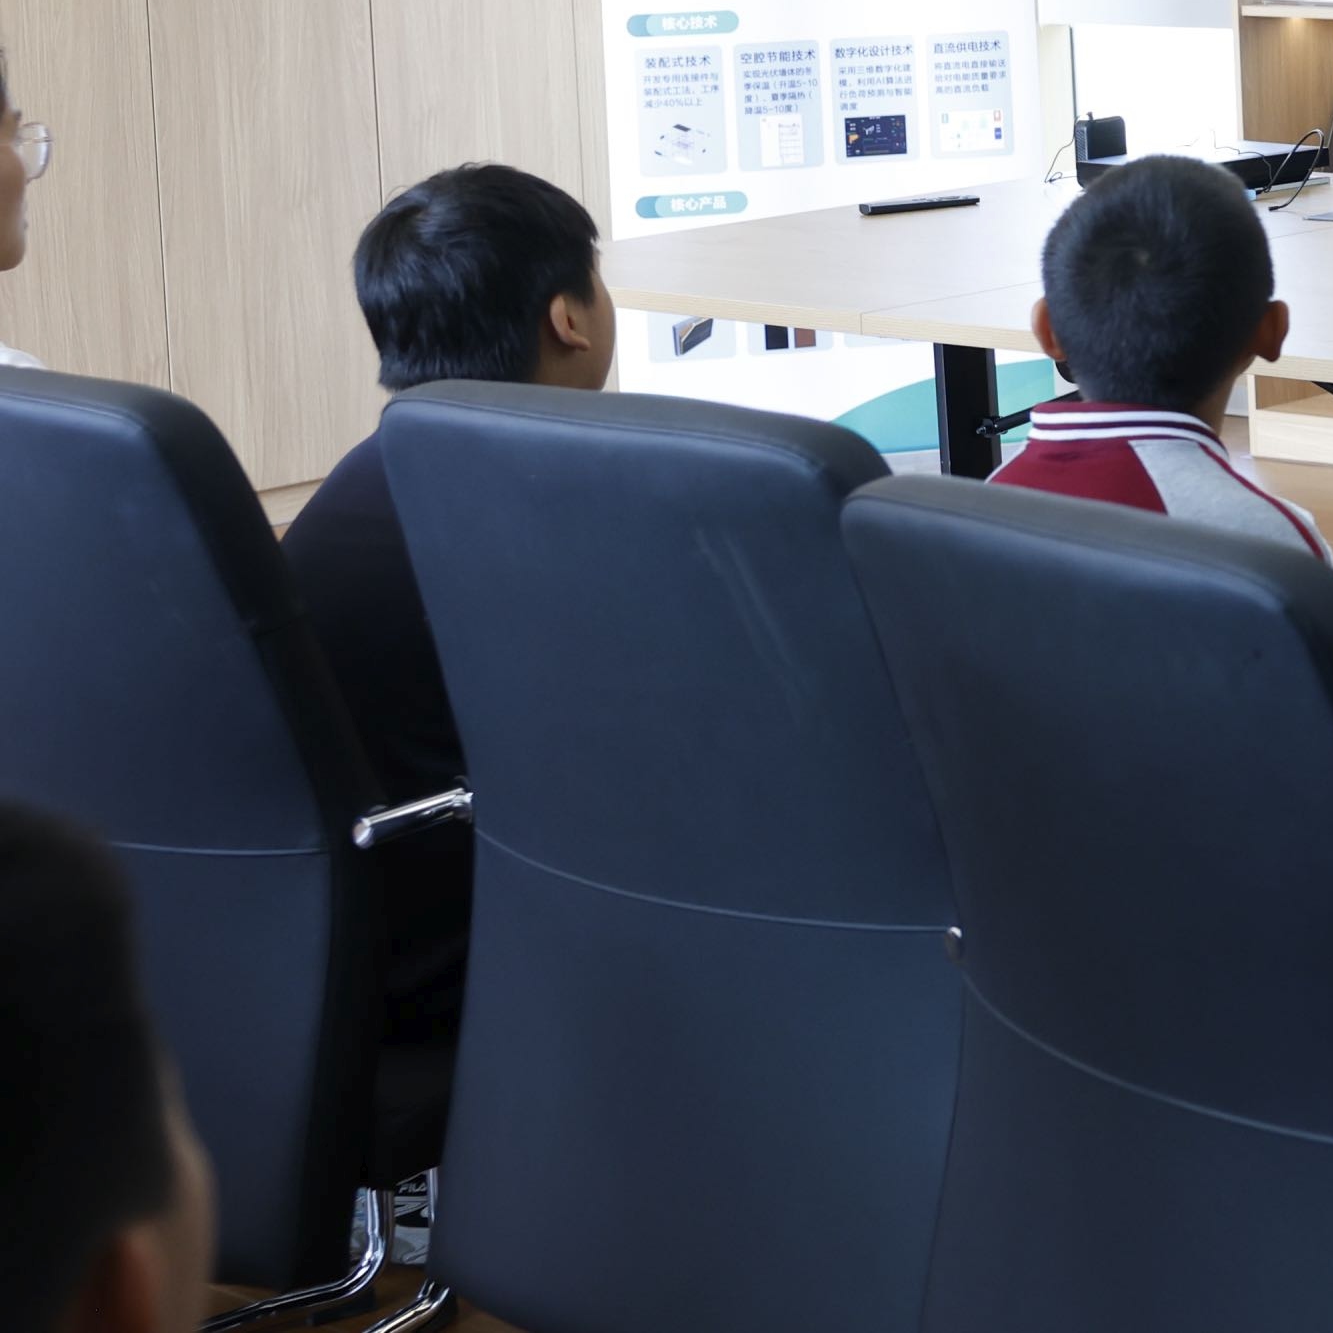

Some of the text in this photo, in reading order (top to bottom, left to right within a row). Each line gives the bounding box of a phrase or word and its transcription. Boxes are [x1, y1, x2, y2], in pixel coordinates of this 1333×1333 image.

[661, 15, 718, 31] 核心技术
[835, 45, 914, 59] 数字化设计技术
[934, 40, 1002, 54] 直流供电技术
[645, 55, 711, 69] 装配式技术
[741, 49, 816, 64] 空腔节能技术
[671, 196, 727, 212] 核心产品
[399, 1183, 427, 1193] FILA
